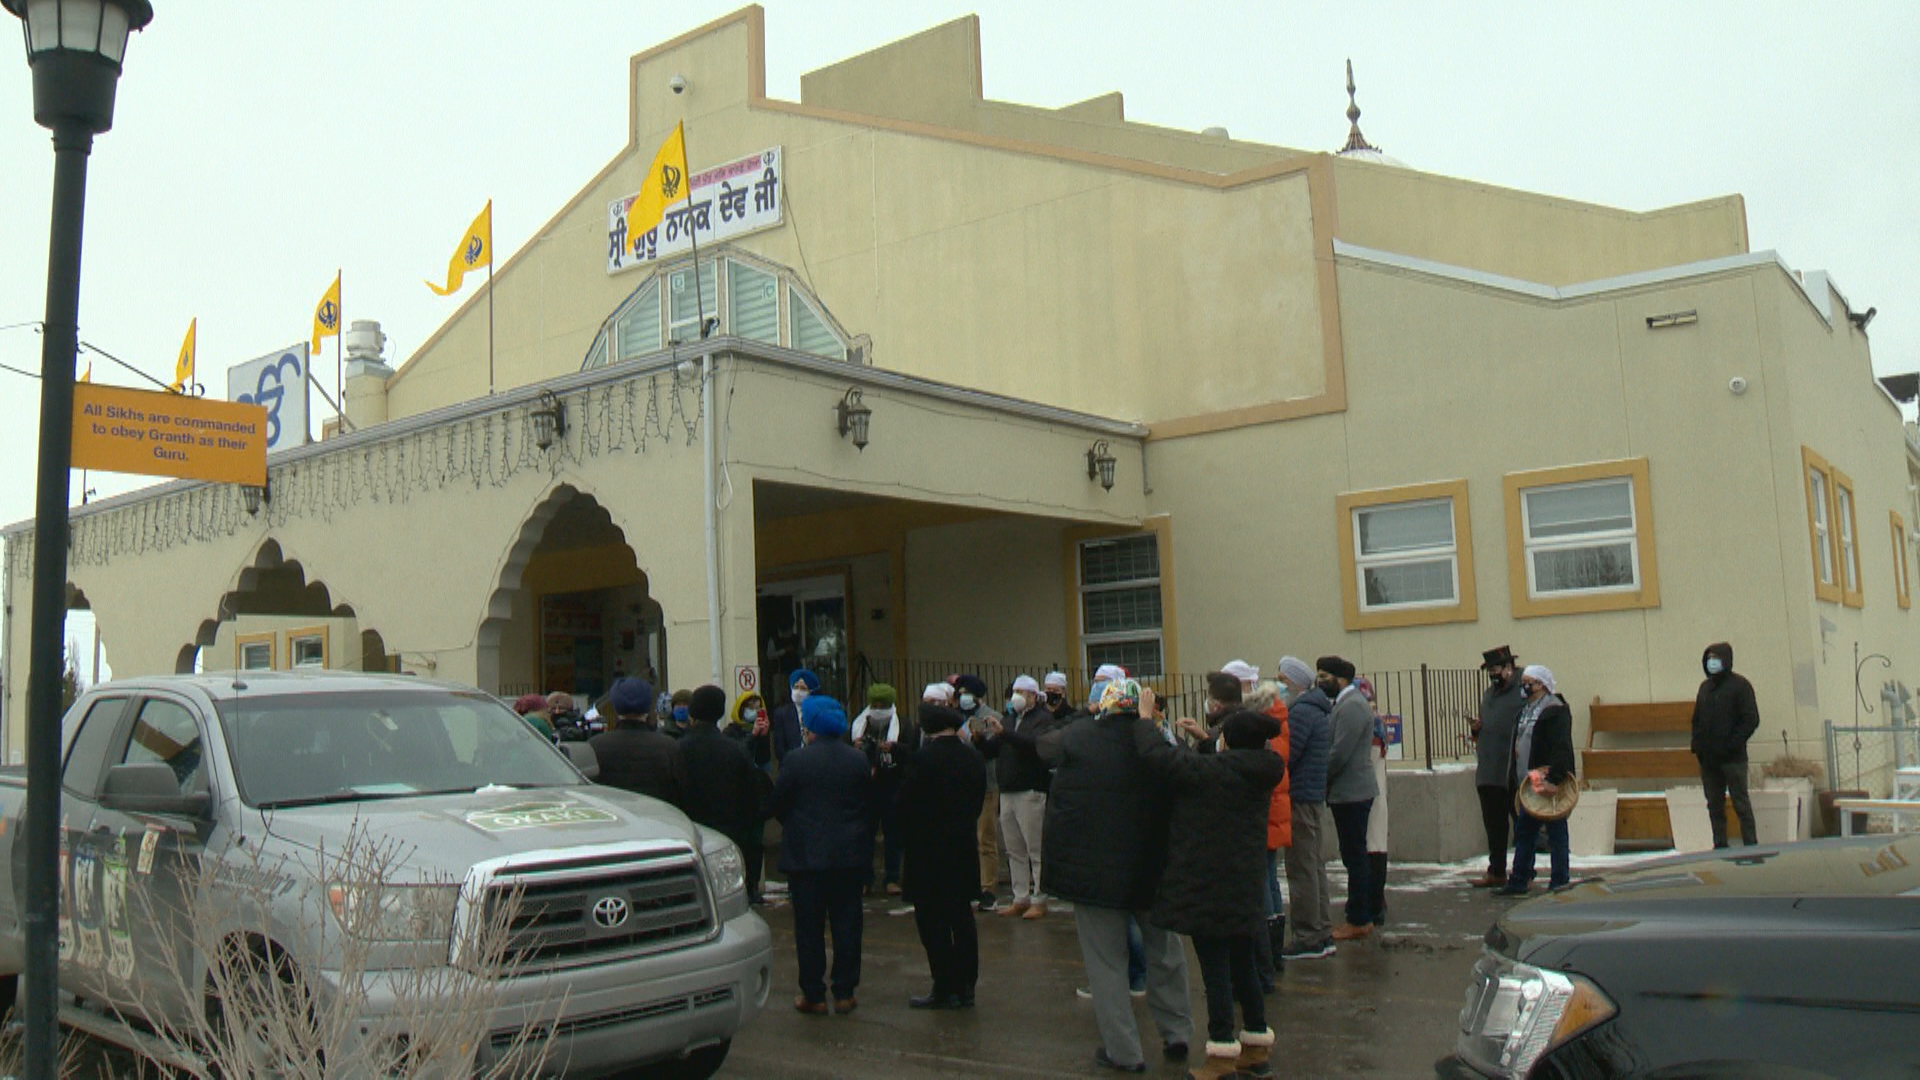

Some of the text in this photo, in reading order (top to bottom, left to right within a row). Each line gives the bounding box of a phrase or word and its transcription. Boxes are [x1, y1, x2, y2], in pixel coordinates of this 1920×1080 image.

[665, 199, 712, 242] ਨਾਨਕ
[719, 181, 749, 222] ਦੇਵ
[754, 167, 777, 213] ਜੀ
[83, 403, 256, 435] All Sikhs are commanded
[92, 423, 248, 450] to obey Granth as their
[153, 446, 189, 461] Guru.
